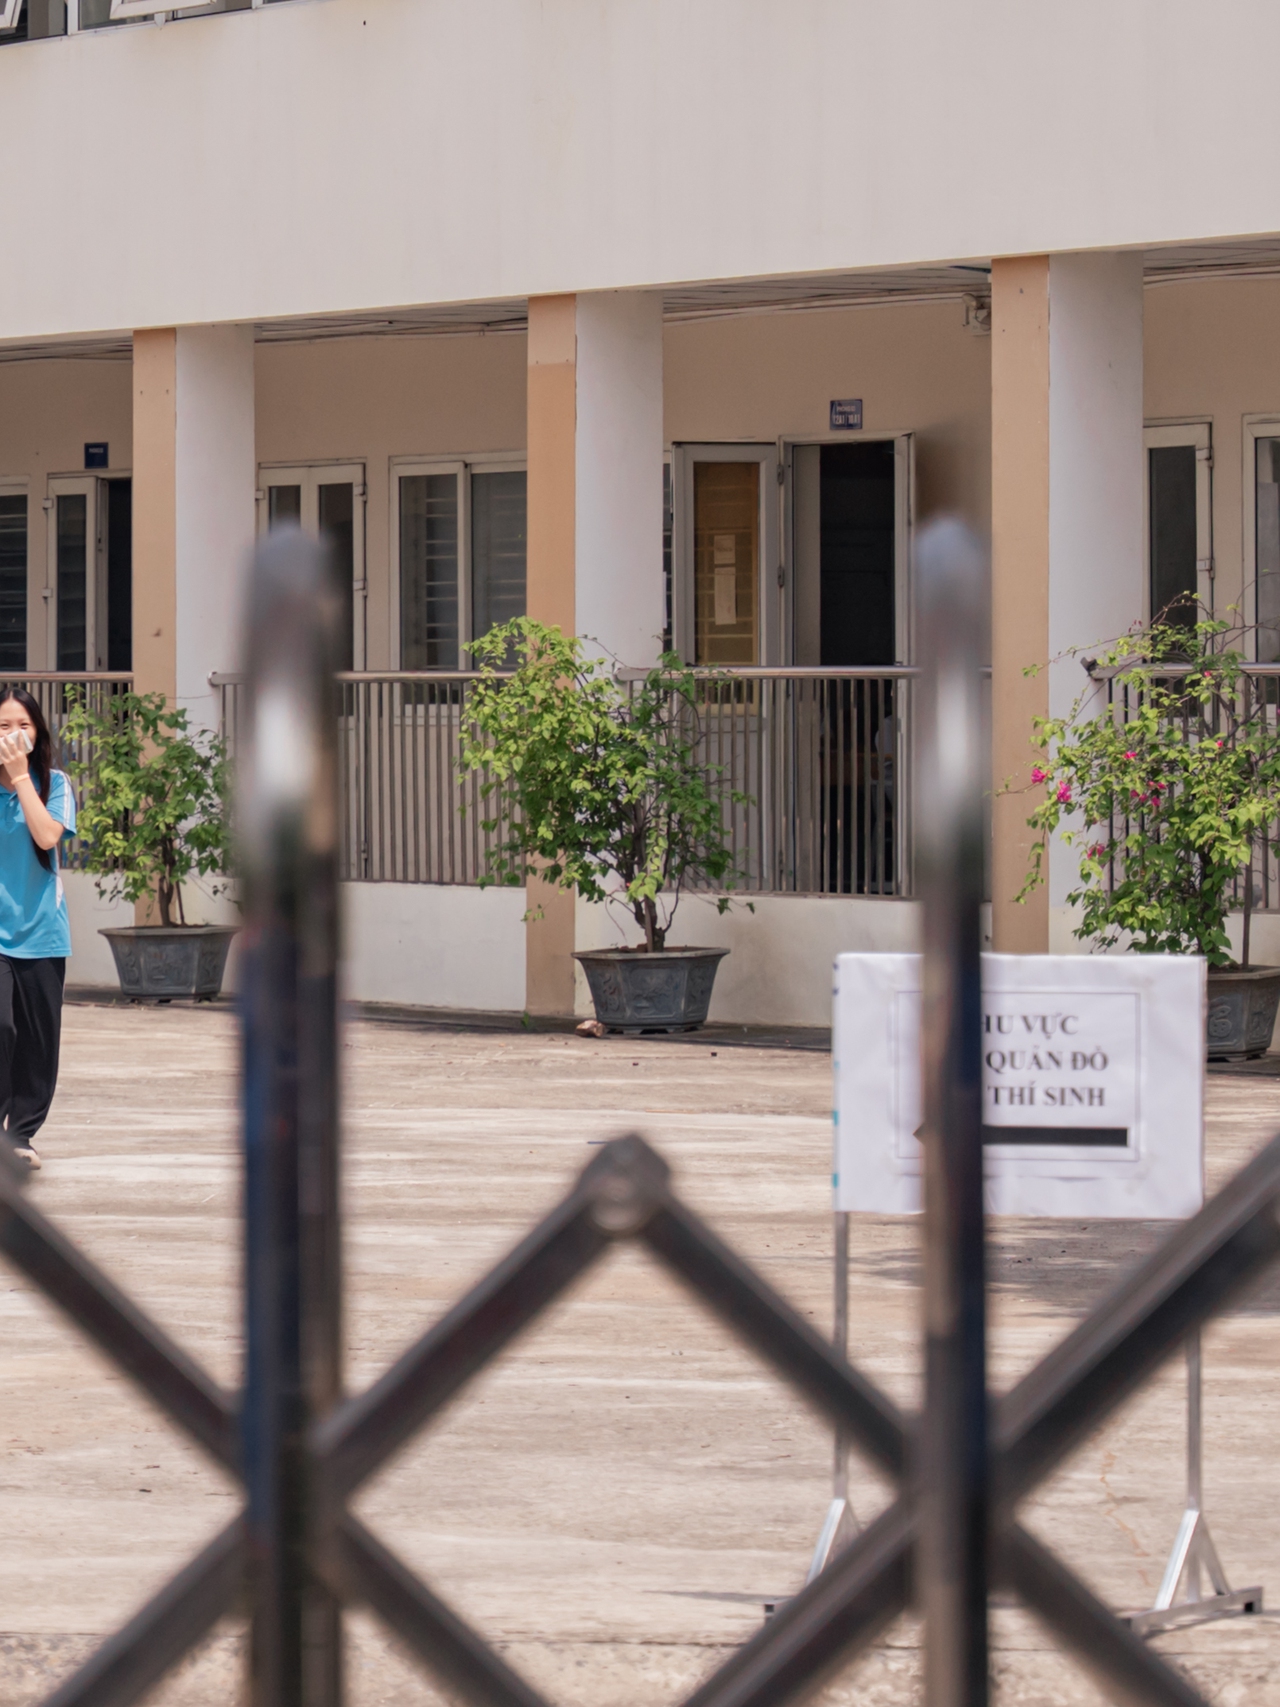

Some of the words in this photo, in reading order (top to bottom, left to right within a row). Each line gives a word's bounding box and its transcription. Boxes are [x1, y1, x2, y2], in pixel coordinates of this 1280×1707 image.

[1022, 1012, 1079, 1040] VỰC
[985, 1045, 1063, 1074] QUẢN
[988, 1080, 1037, 1106] THÍ
[1043, 1086, 1106, 1107] SINH
